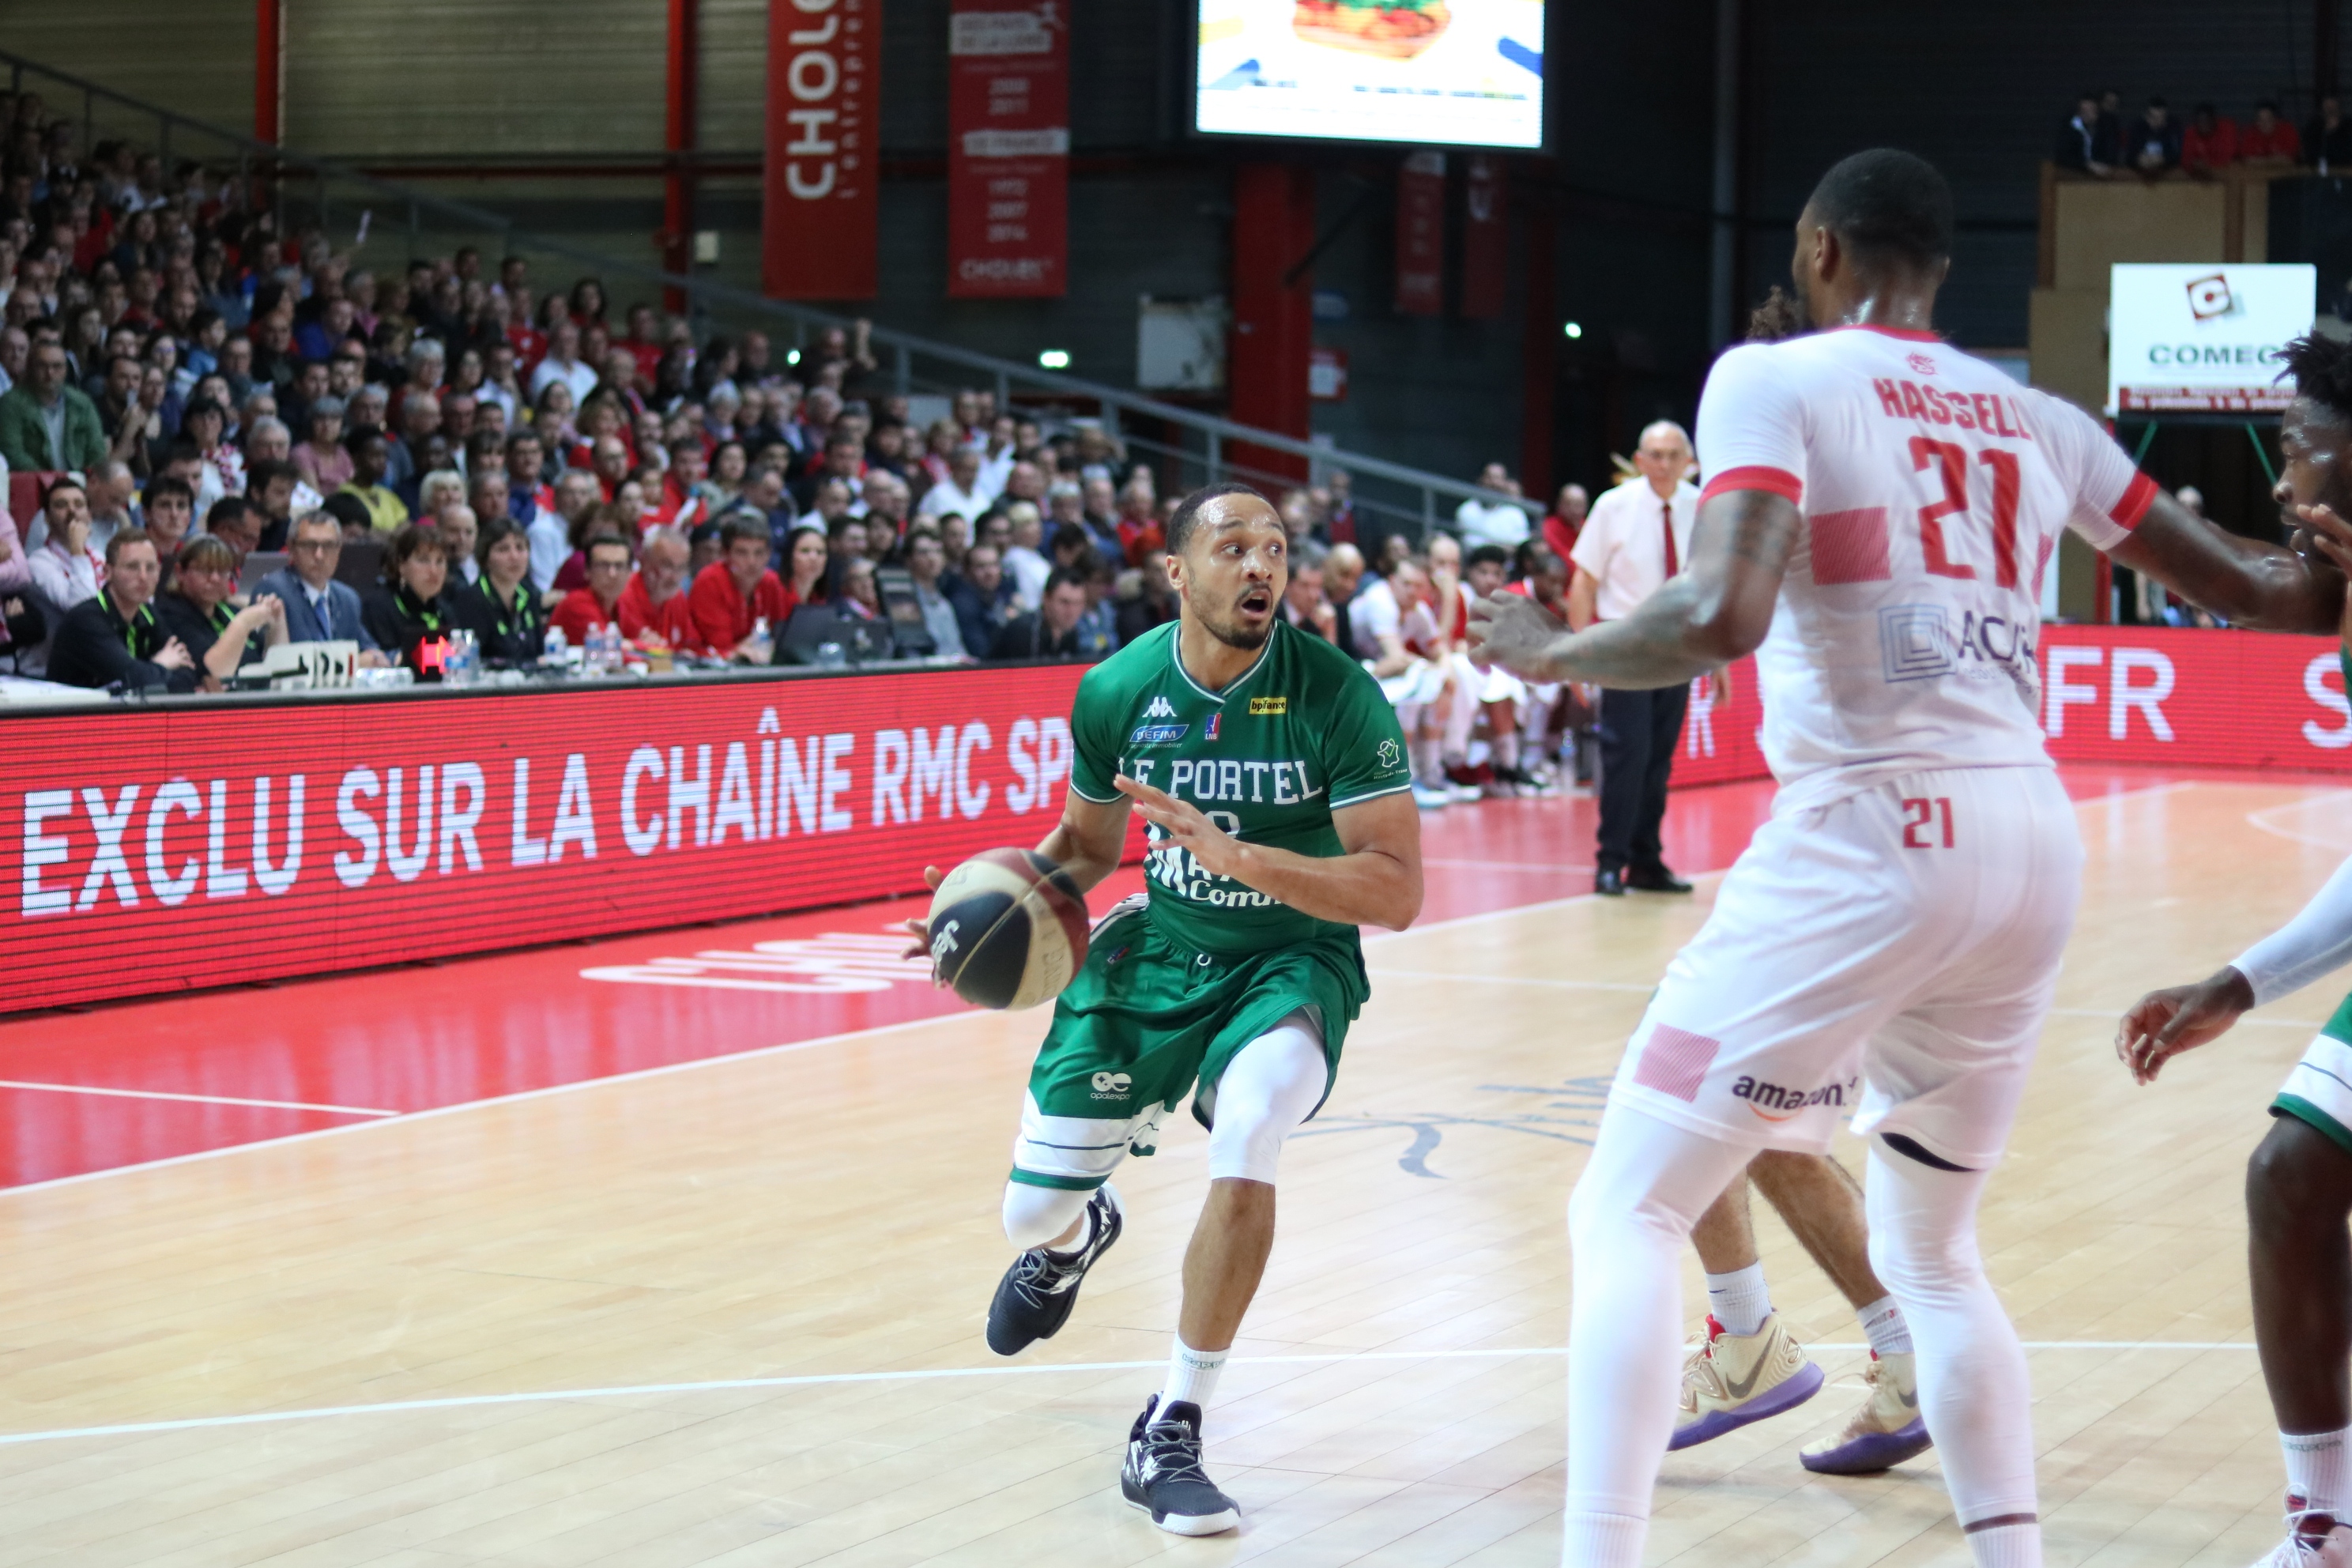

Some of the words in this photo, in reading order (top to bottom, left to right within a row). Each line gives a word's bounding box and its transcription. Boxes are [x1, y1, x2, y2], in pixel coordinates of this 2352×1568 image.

[1872, 378, 2033, 441] HASSELL
[1907, 435, 2021, 590] 21
[1170, 759, 1324, 805] PORTEL
[21, 772, 306, 918] EXCLU
[334, 760, 487, 888] SUR
[511, 752, 598, 867] LA
[620, 706, 855, 857] CHAÎNE
[872, 720, 992, 827] RMC
[1006, 715, 1075, 816] SP
[1901, 796, 1954, 849] 21
[1090, 1092, 1131, 1101] opalexpo
